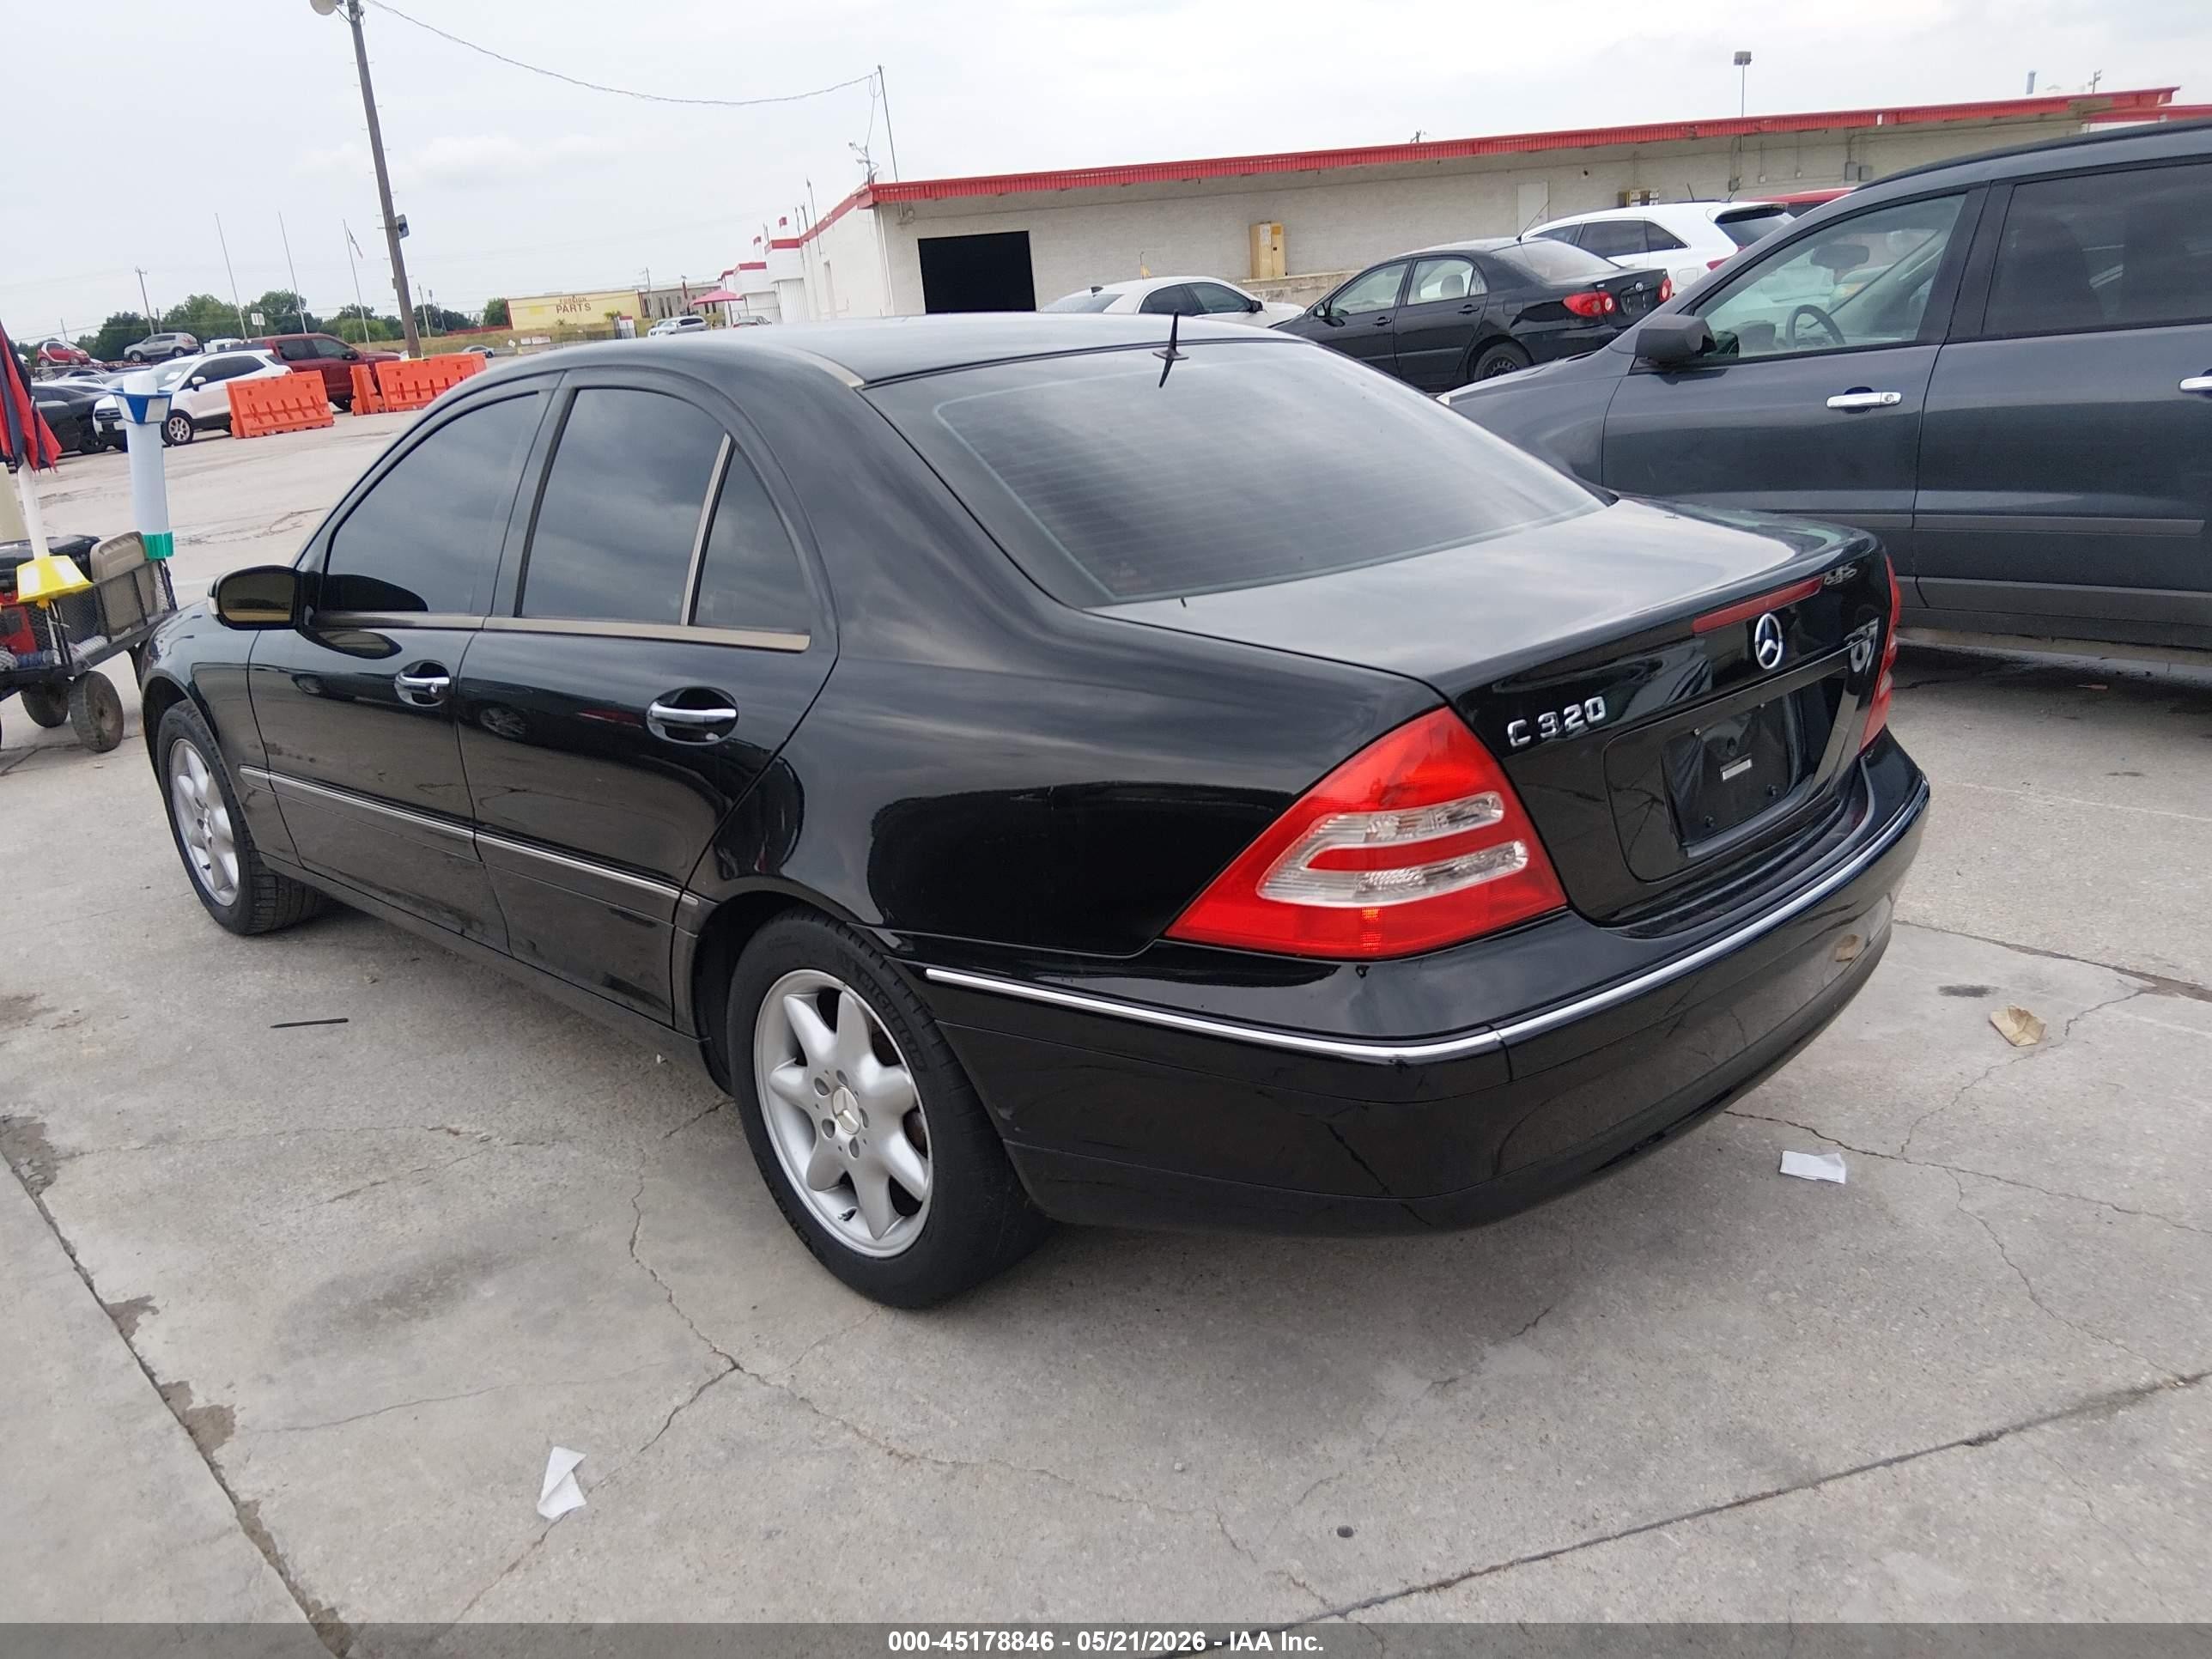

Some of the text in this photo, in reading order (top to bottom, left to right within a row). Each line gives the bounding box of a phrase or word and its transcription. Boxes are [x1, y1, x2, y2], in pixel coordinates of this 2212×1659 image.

[556, 302, 592, 314] PARTS
[1507, 696, 1607, 747] C 320
